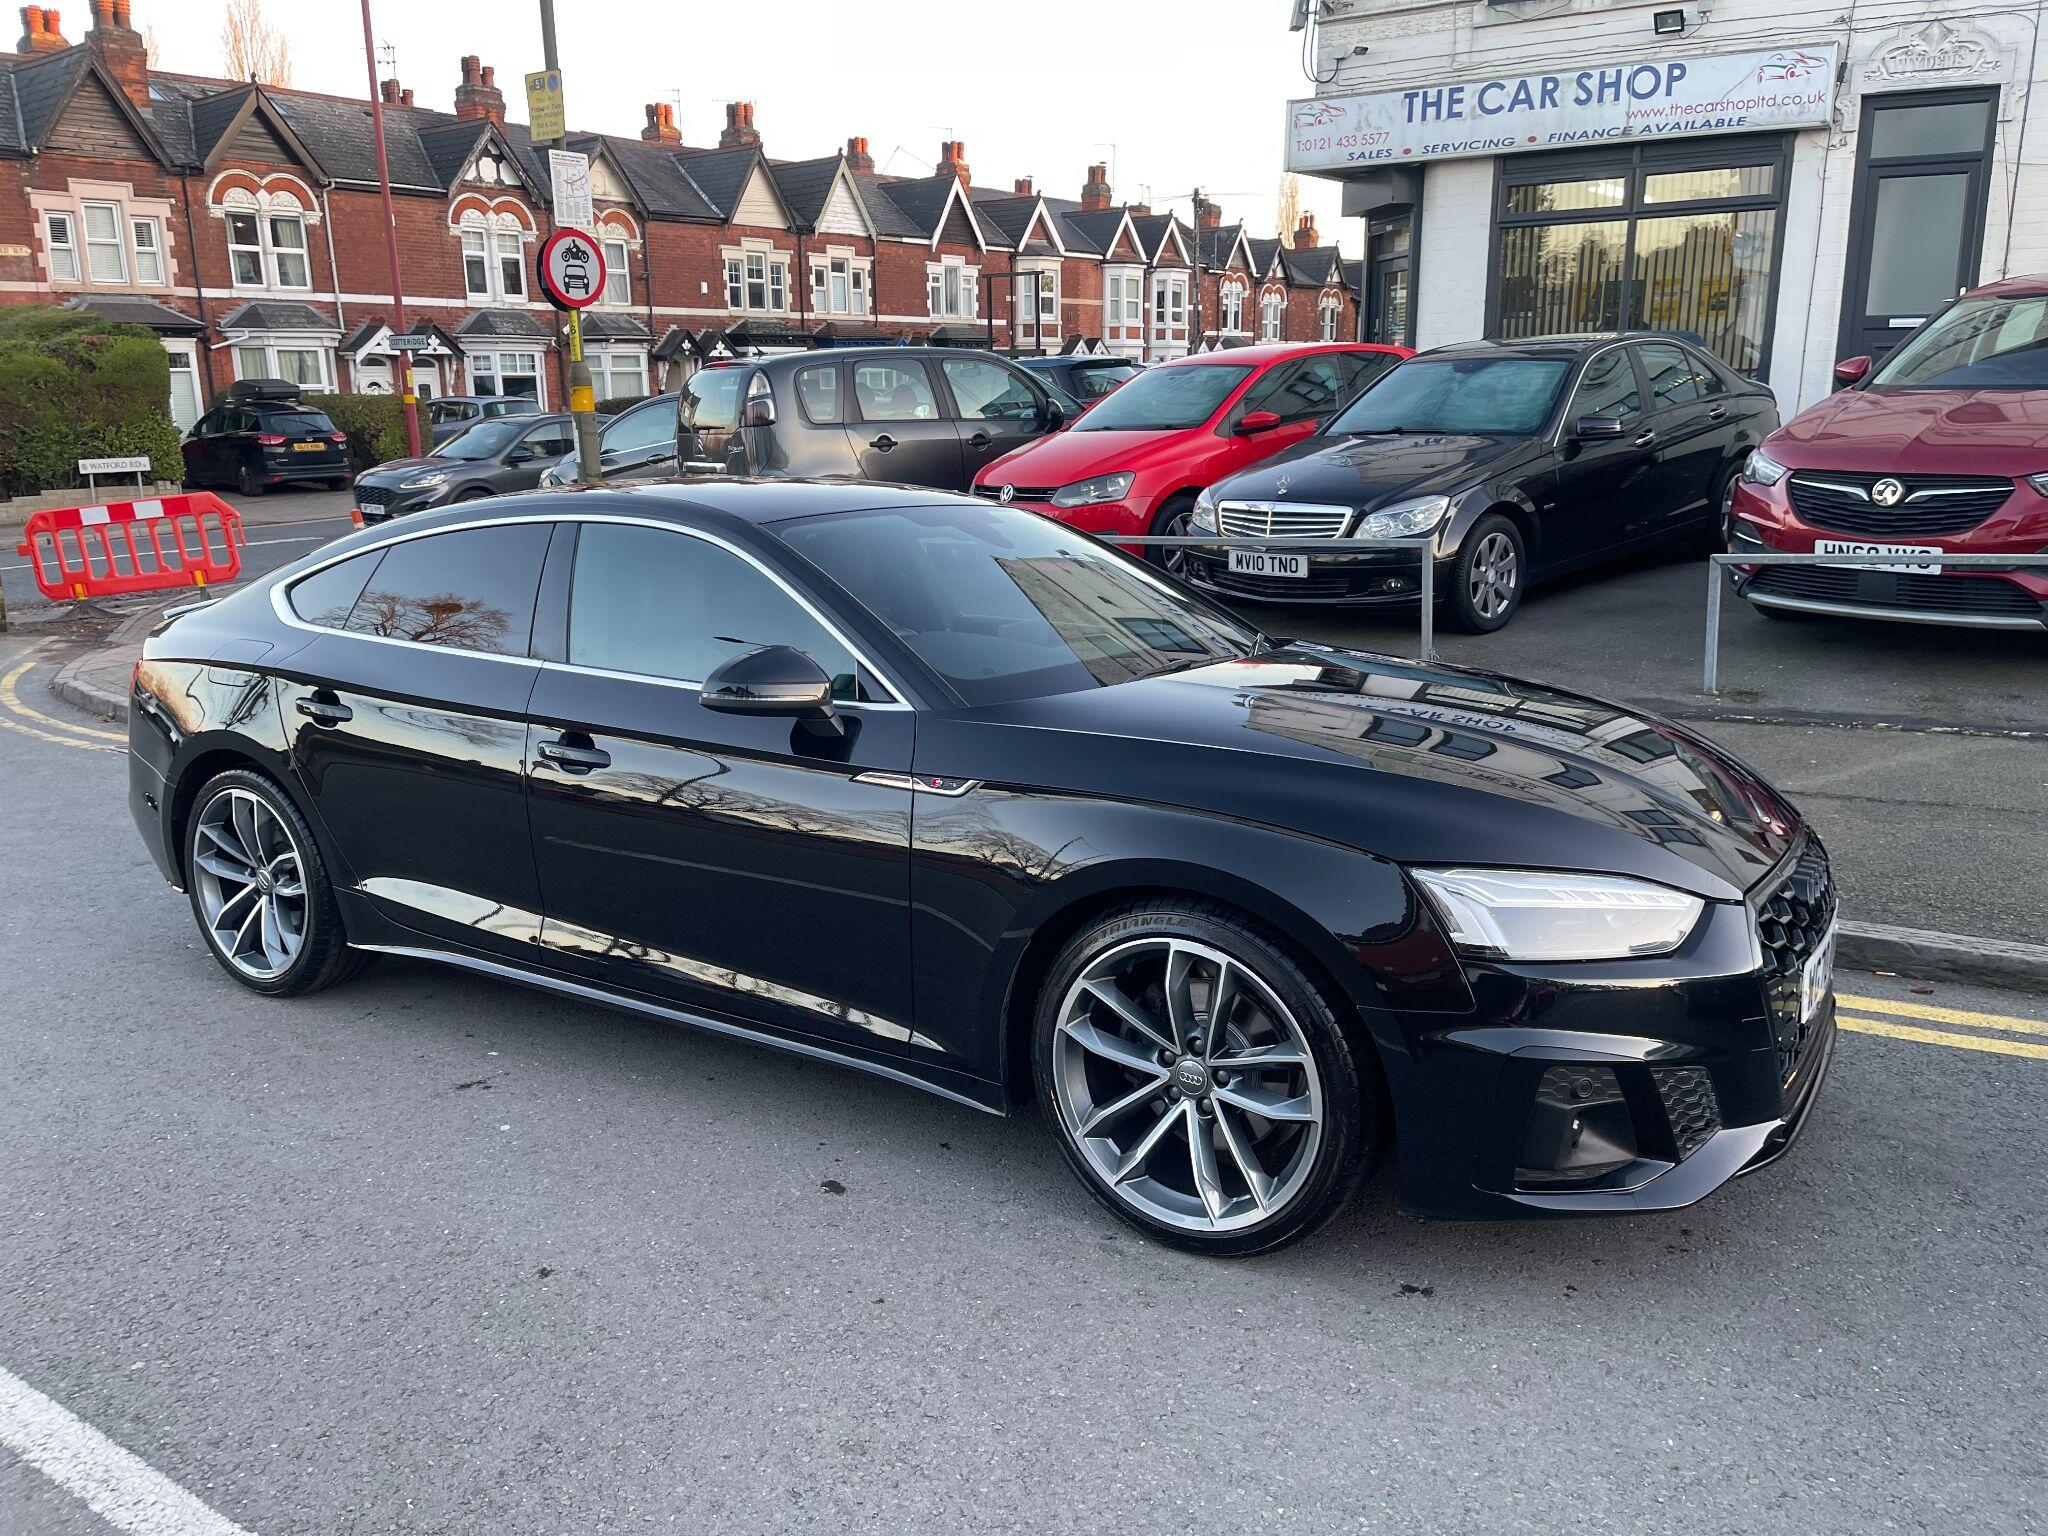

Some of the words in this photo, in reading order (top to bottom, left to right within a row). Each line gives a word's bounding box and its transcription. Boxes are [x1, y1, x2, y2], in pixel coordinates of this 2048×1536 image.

[1404, 86, 1465, 123] THE
[1477, 76, 1560, 115] CAR
[1573, 63, 1687, 107] SHOP
[1626, 91, 1825, 121] www.thecarshopltd.co.uk
[1296, 138, 1332, 152] T:0121
[1336, 135, 1358, 149] 433
[1361, 132, 1390, 146] 5577
[1347, 148, 1393, 162] SALES
[1422, 137, 1516, 155] SERVICING
[1548, 126, 1634, 142] FINANCE
[1638, 116, 1747, 134] AVAILABLE
[89, 461, 128, 470] WATFORD
[129, 460, 142, 468] RD
[1236, 553, 1264, 571] MV10
[1268, 556, 1299, 574] TNO
[1099, 915, 1190, 939] TRIANGLE
